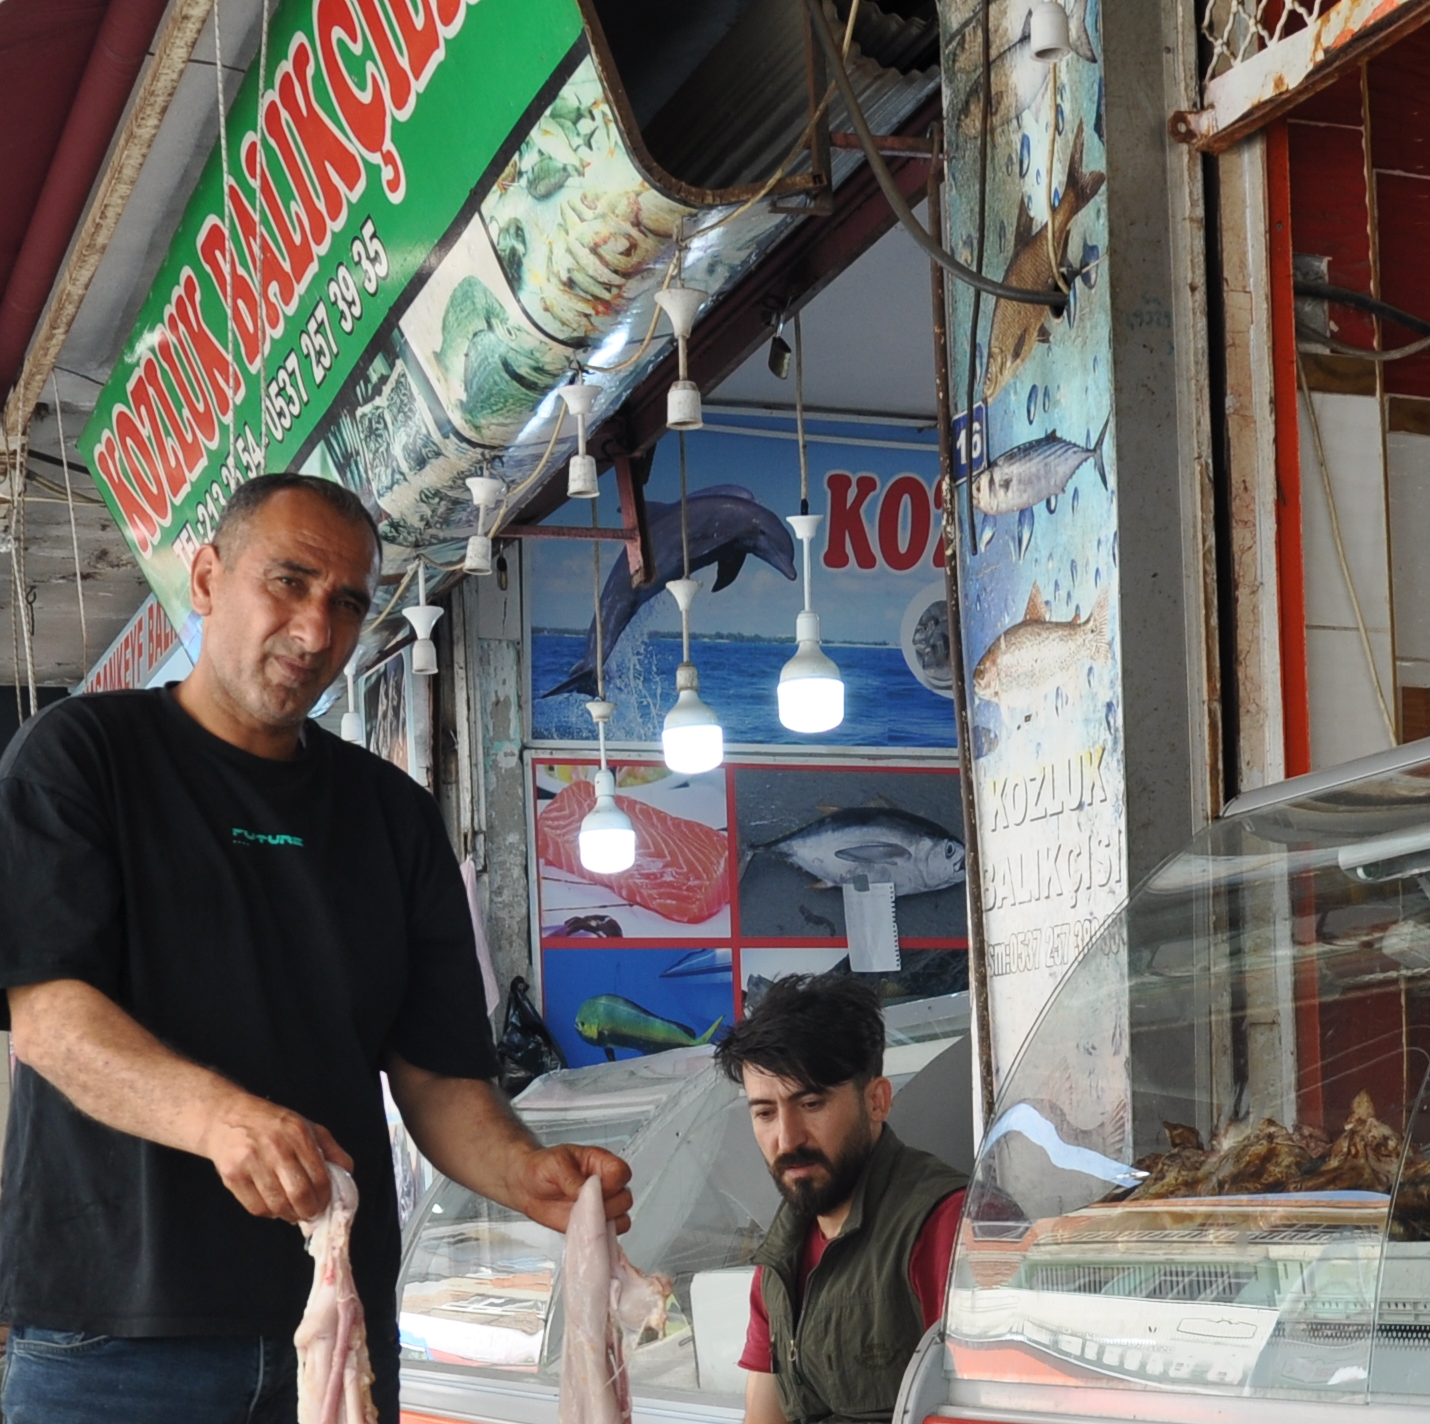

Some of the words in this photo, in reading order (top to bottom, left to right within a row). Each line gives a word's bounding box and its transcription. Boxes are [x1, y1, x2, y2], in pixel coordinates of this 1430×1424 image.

[265, 350, 309, 443] 0537
[300, 297, 338, 389] 257
[328, 262, 362, 336] 39
[351, 215, 388, 297] 35
[94, 265, 246, 559] KOZLUK
[956, 421, 982, 465] 16
[988, 745, 1108, 833] KOZLUK
[1044, 922, 1071, 969] 257
